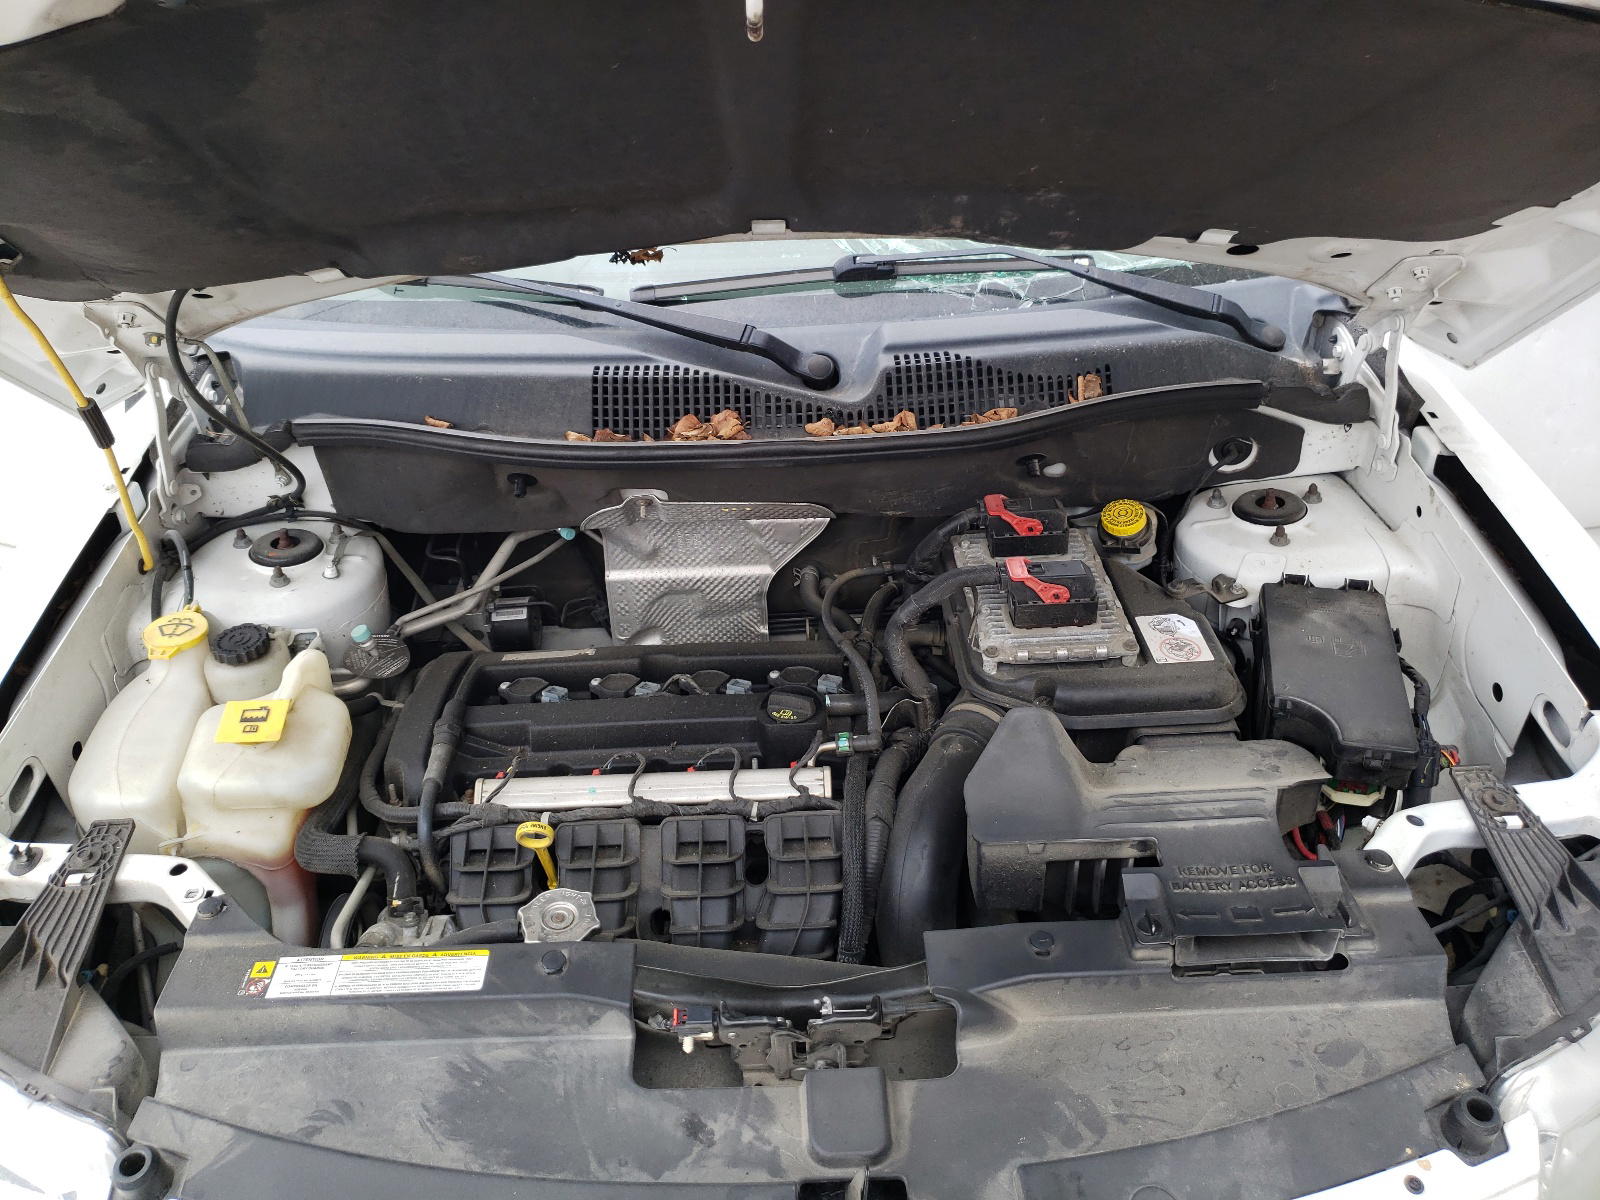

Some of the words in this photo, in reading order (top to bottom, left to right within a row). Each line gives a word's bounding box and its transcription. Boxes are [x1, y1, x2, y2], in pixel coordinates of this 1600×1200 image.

[1178, 865, 1238, 877] REMOVE
[1243, 863, 1273, 875] FOR
[1170, 881, 1232, 893] BATTERY
[1240, 876, 1297, 891] ACCESS
